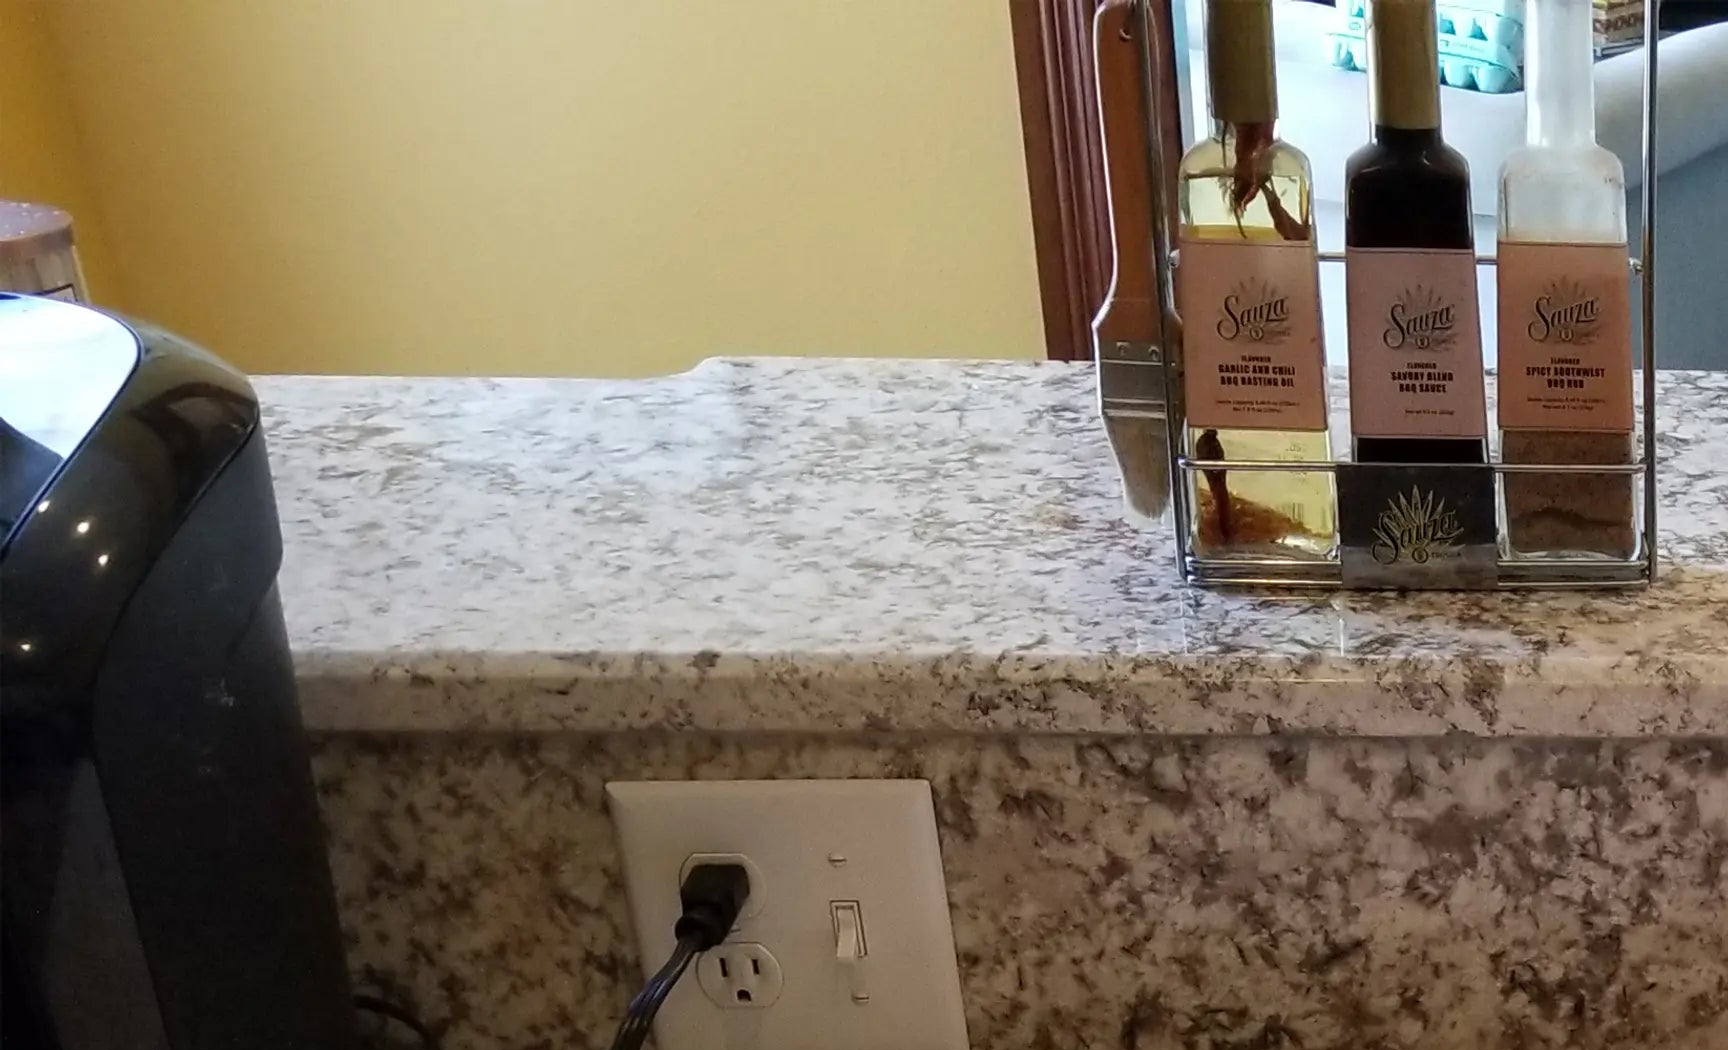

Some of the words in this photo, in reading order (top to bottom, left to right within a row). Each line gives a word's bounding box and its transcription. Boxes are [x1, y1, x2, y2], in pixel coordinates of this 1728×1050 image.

[1217, 295, 1289, 340] Sauza
[1528, 296, 1600, 341] Sauza
[1383, 303, 1455, 348] Sauza
[1218, 364, 1250, 374] GARLIC
[1526, 366, 1551, 376] SPICY
[1391, 371, 1424, 381] SAVORY
[1220, 376, 1239, 386] BBQ
[1241, 376, 1278, 387] BASTING
[1281, 378, 1295, 388] OIL
[1399, 383, 1417, 394] BBQ
[1419, 384, 1447, 393] SAUCE
